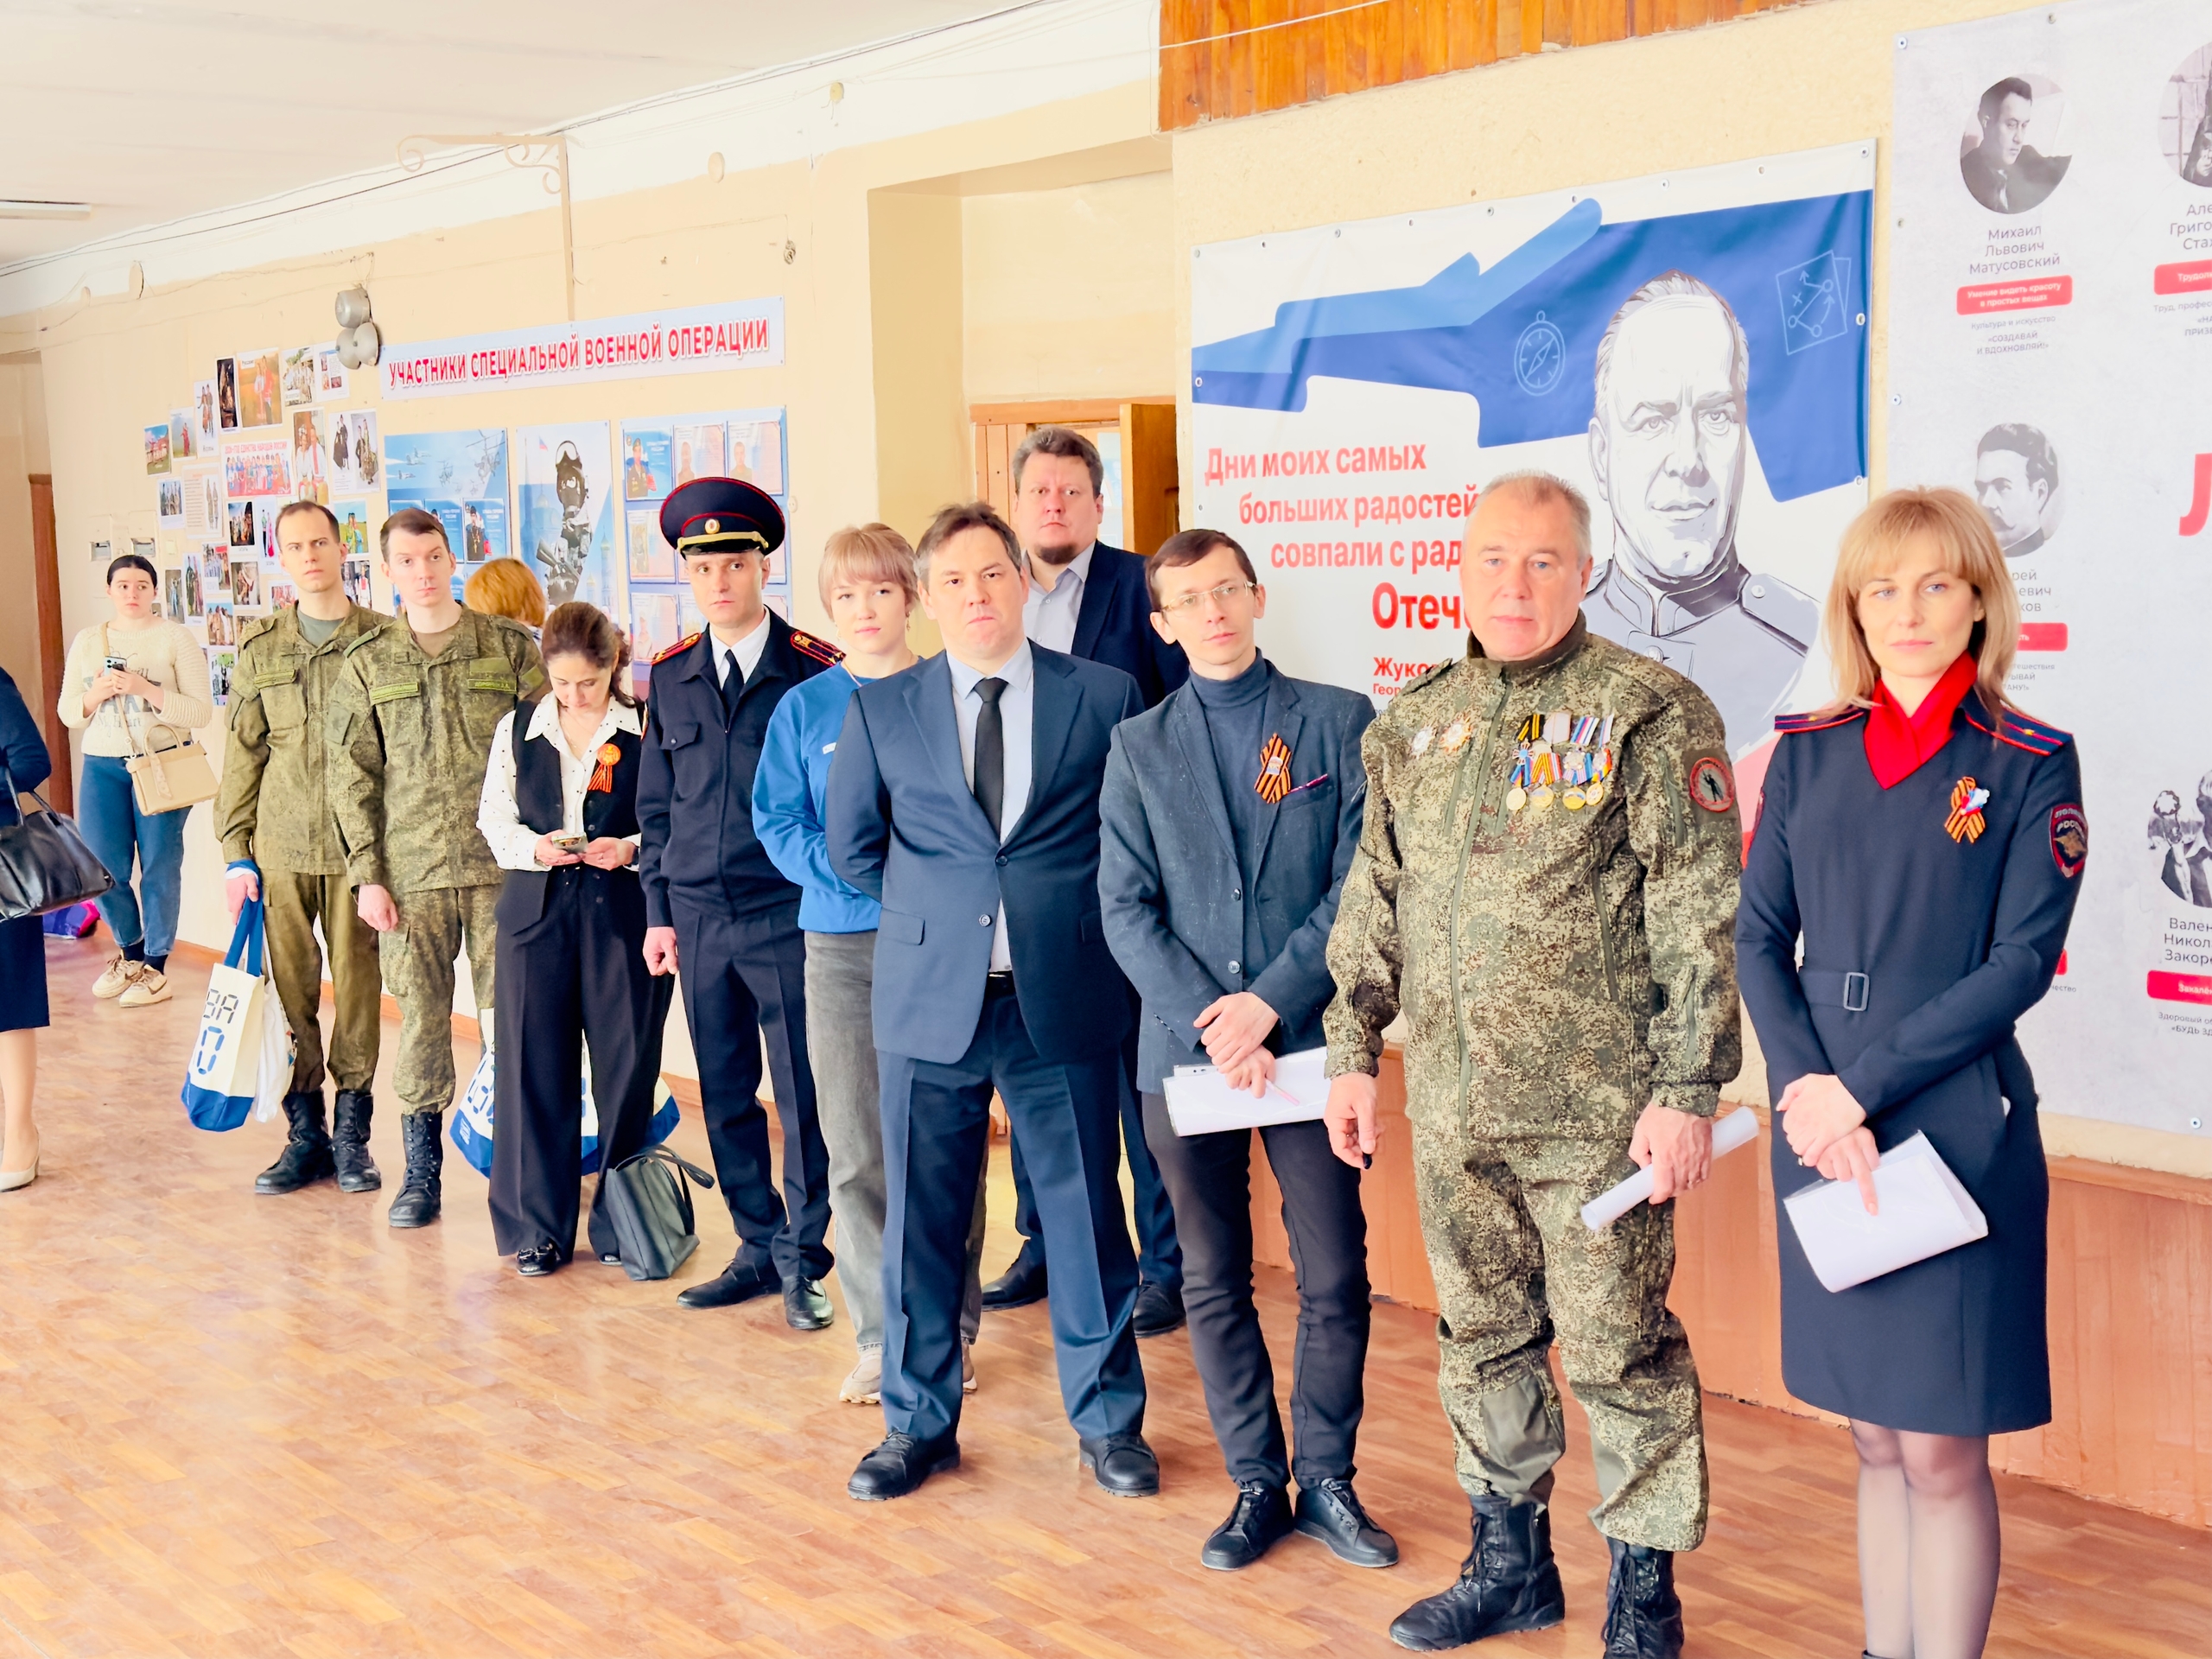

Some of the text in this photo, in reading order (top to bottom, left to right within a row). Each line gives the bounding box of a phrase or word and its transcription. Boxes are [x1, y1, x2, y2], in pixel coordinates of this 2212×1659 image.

[1988, 226, 2042, 241] Михаил
[1985, 242, 2045, 257] Львович
[1969, 252, 2061, 275] Матусовский
[1967, 283, 2062, 299] Умение видеть красоту
[1987, 296, 2020, 307] простых
[2022, 294, 2048, 303] вещах
[1972, 321, 2006, 331] Культура
[2016, 315, 2056, 326] искусство
[1988, 330, 2037, 343] «СОЗДАВАЙ
[389, 353, 466, 387] УЧАСТНИКИ
[471, 334, 579, 379] СПЕЦИАЛЬНОЙ
[585, 323, 662, 365] ВОЕННОЙ
[668, 319, 768, 357] ОПЕРАЦИИ
[1985, 342, 2049, 355] ВДОХНОВЛЯЙ!»
[1205, 443, 1427, 486] Дни моих самых
[1239, 484, 1480, 528] больших радостей
[1271, 538, 1462, 575] совпали с рад
[2012, 569, 2037, 581] рей
[2018, 588, 2051, 596] евич
[1372, 582, 1471, 630] Отеч
[1373, 657, 1438, 682] Жуко
[2010, 672, 2036, 681] ЫВАЙ
[1373, 683, 1402, 697] Геор
[2164, 933, 2212, 949] Никол
[2158, 1012, 2202, 1023] Здоровый
[2171, 1024, 2200, 1035] «БУДЬ
